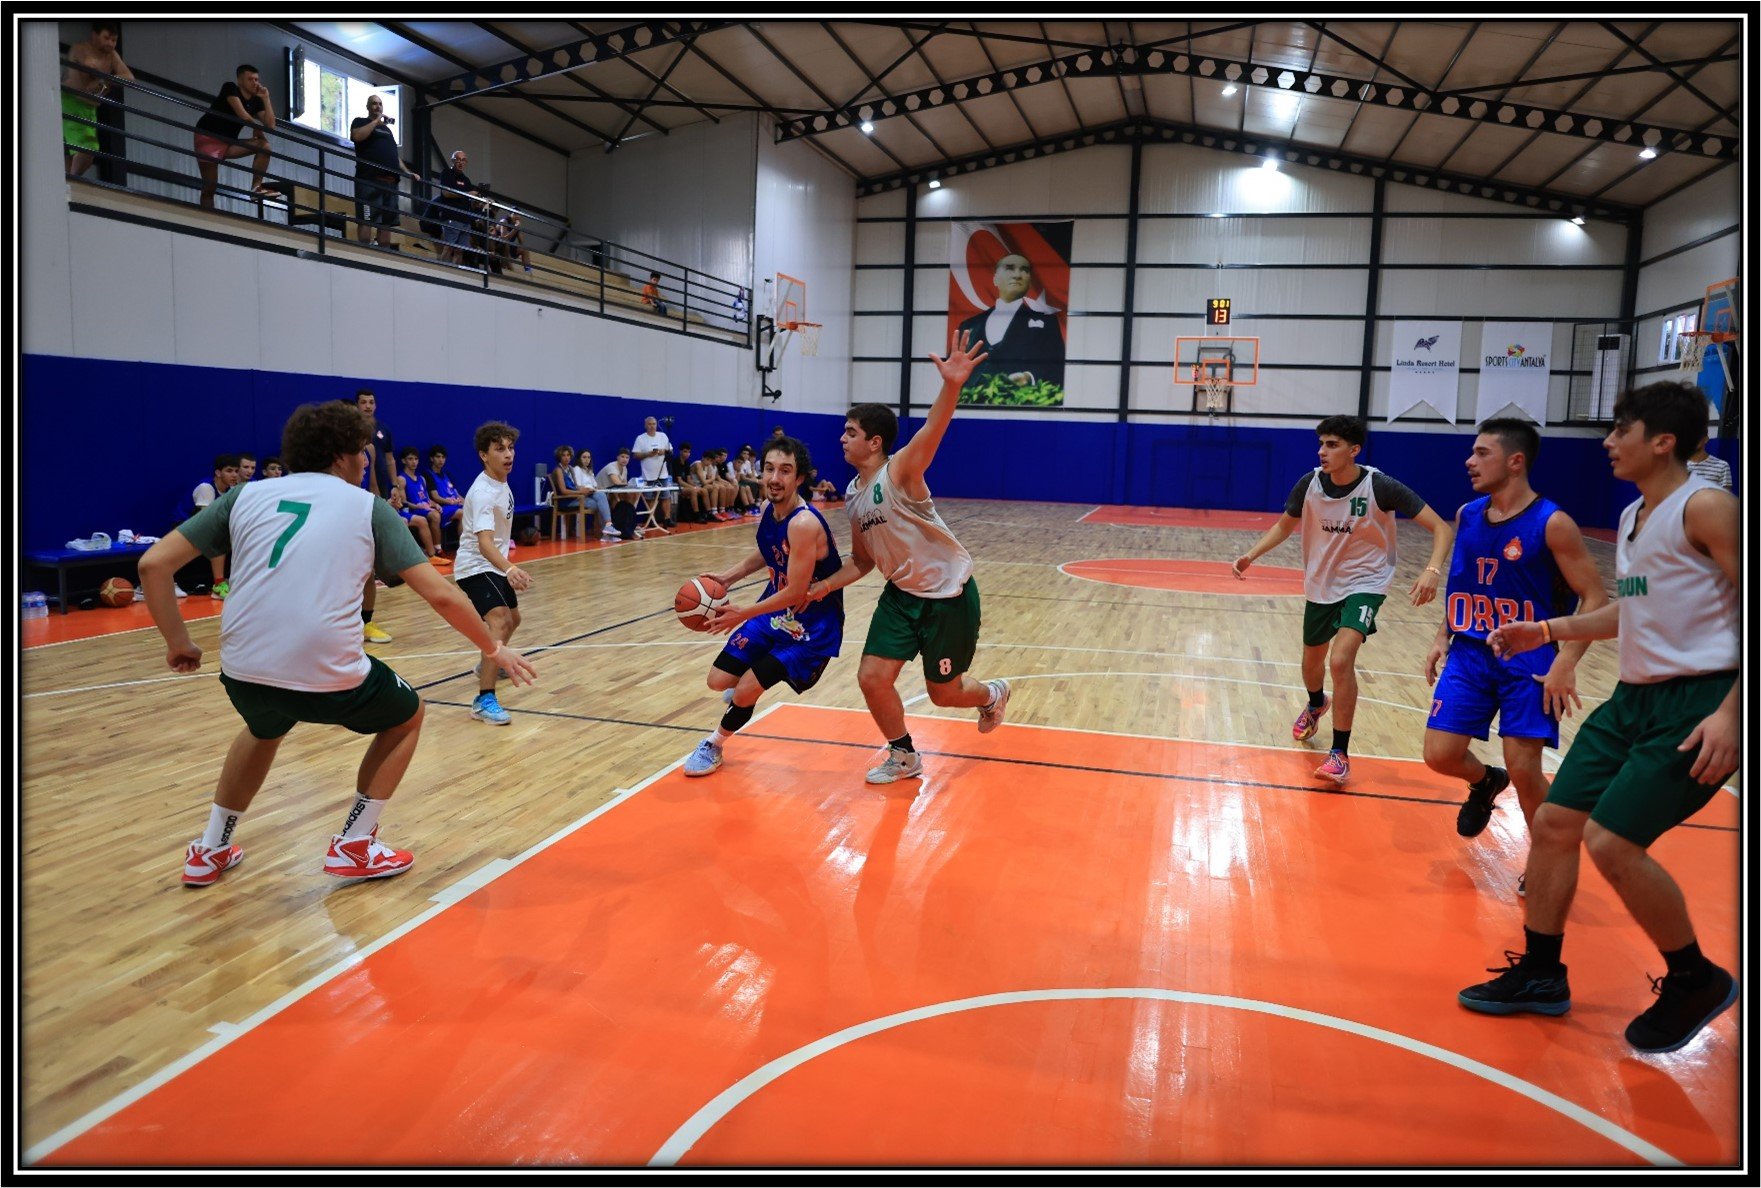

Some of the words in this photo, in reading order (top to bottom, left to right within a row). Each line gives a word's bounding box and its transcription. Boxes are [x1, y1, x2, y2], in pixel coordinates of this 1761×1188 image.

[1214, 309, 1227, 323] 13
[1396, 359, 1415, 367] Linda
[873, 483, 884, 504] 8
[1350, 497, 1367, 517] 15
[268, 500, 311, 568] 7
[1476, 557, 1499, 585] 17
[1358, 605, 1374, 628] 15
[939, 658, 952, 675] 8
